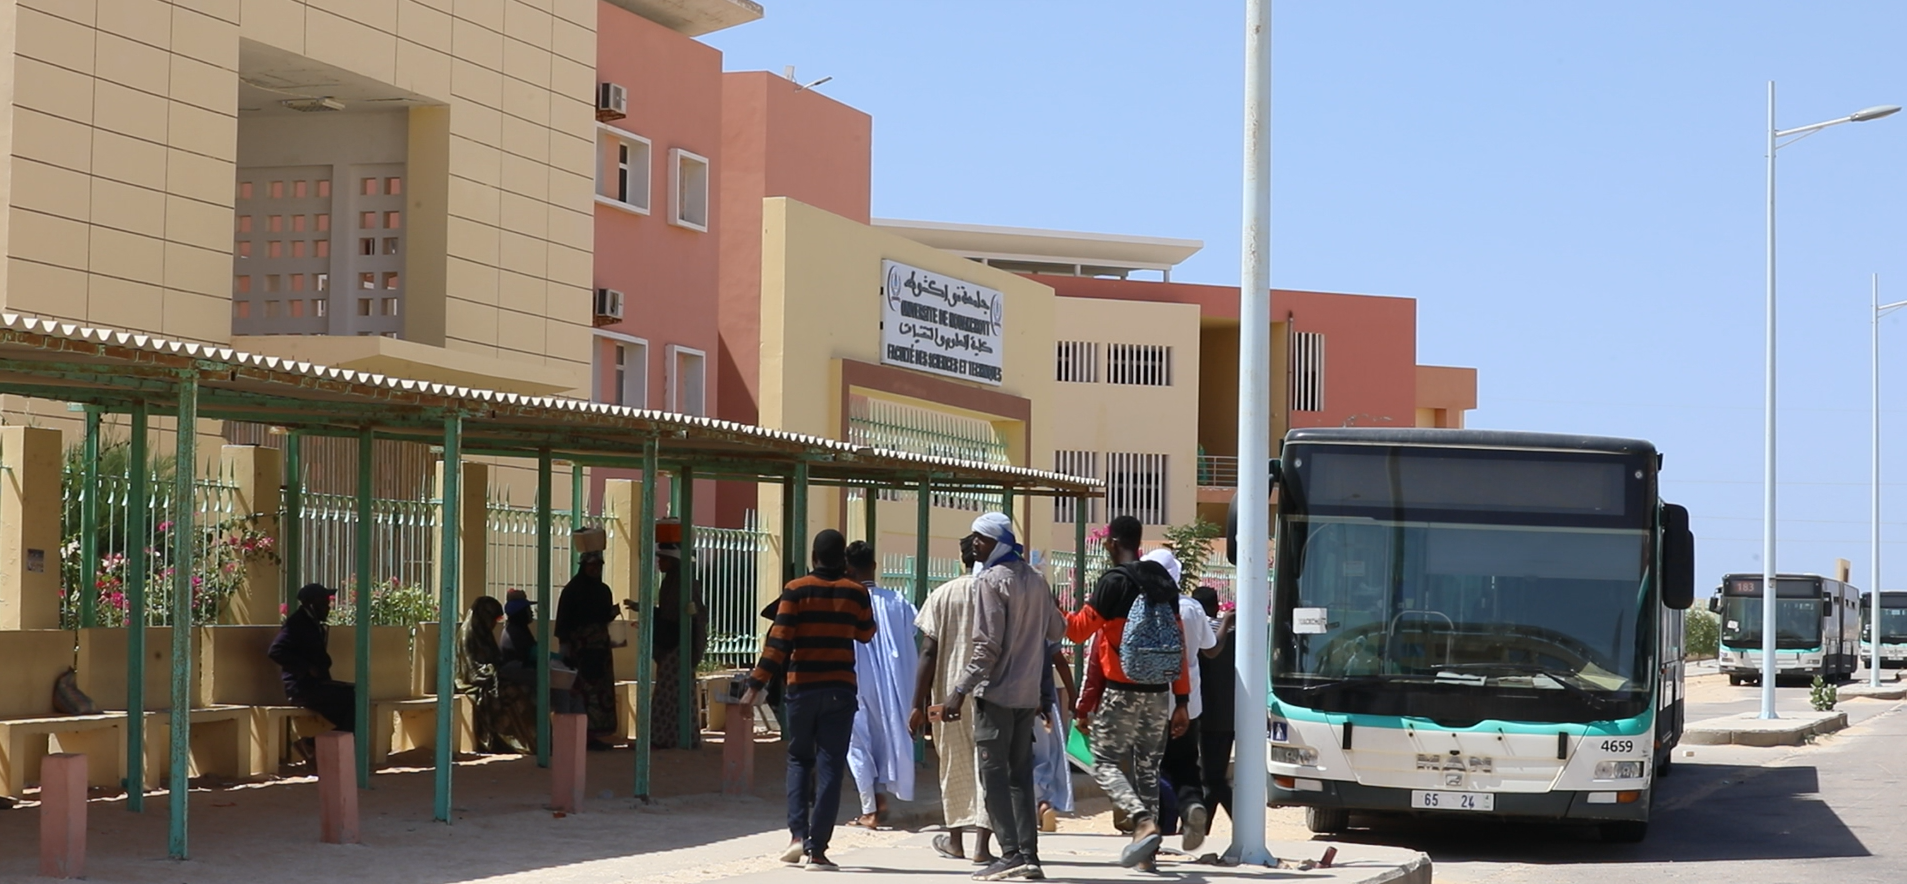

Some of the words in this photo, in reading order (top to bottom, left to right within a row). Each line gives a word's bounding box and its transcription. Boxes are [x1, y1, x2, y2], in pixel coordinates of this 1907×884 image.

[939, 309, 949, 326] DE
[915, 349, 928, 367] DES
[928, 352, 958, 373] SCIENCES
[959, 359, 968, 375] ET
[1737, 582, 1754, 592] 183
[1600, 740, 1633, 753] 4659
[1417, 754, 1492, 772] MAN
[1424, 793, 1439, 807] 65
